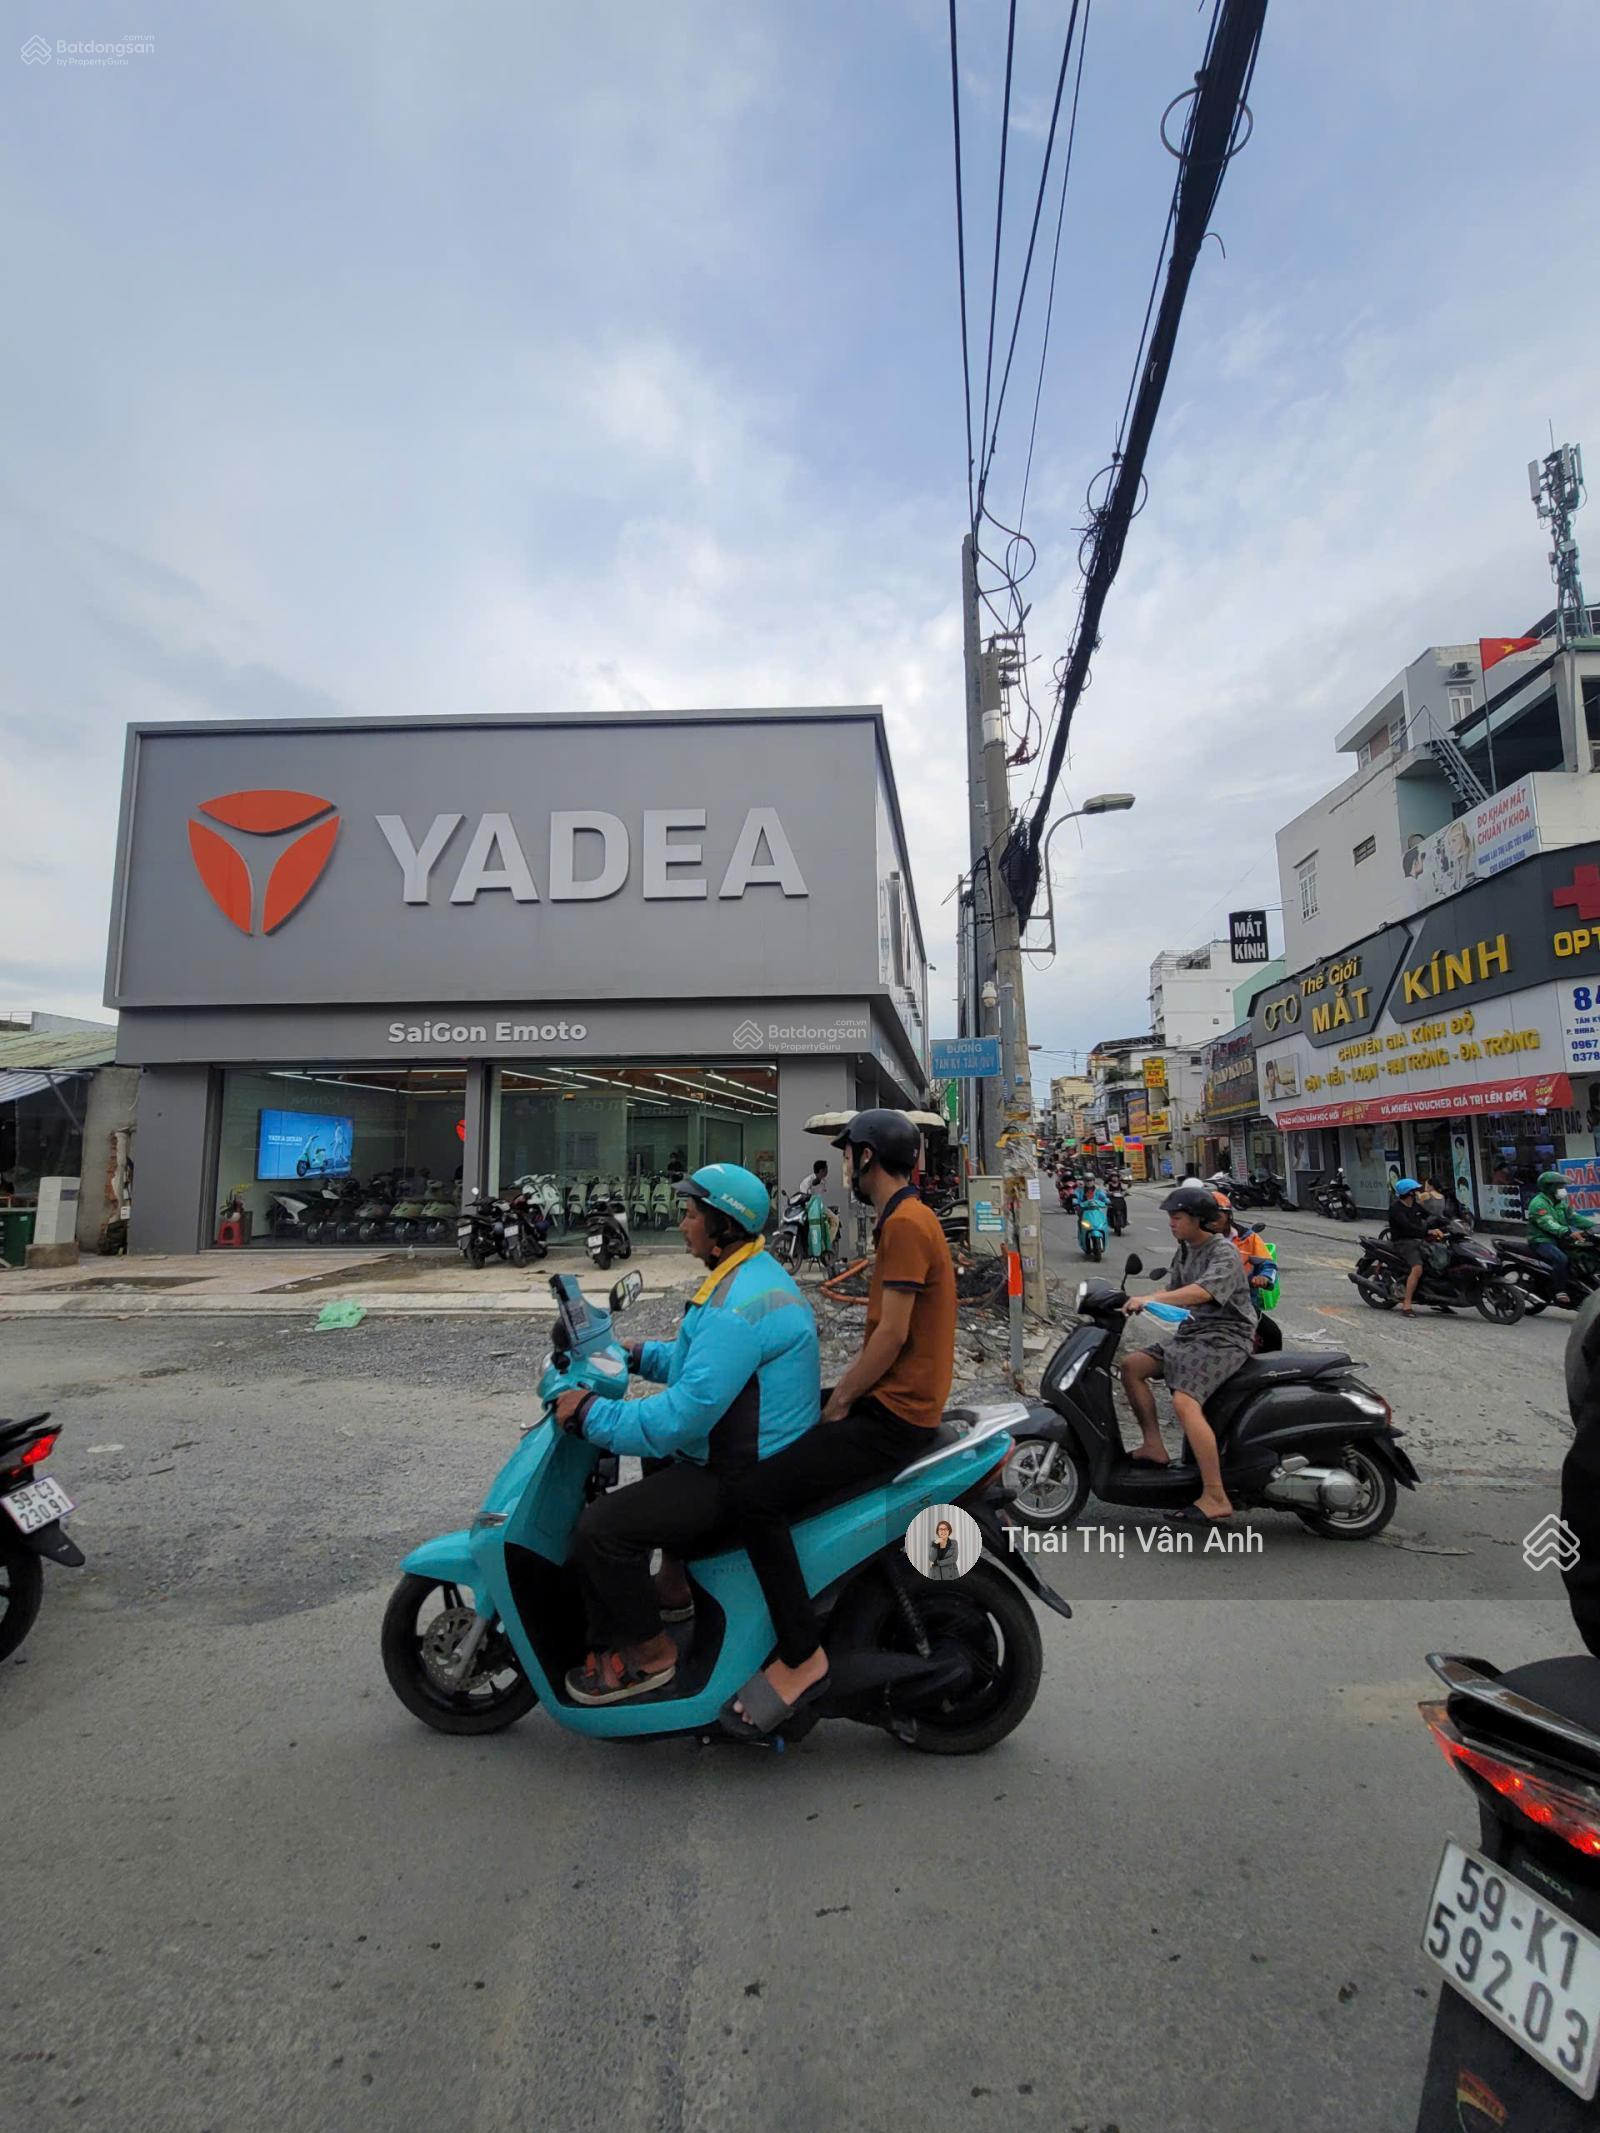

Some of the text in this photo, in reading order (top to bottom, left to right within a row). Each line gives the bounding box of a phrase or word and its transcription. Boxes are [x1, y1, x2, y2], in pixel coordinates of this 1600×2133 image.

[375, 807, 809, 905] YADEA
[1233, 914, 1263, 938] MẮT
[1234, 939, 1266, 960] KÍNH
[1300, 956, 1357, 997] Thế Giới
[1311, 933, 1511, 1034] MẮT KÍNH
[388, 1021, 587, 1043] SaiGon Emoto
[1386, 1031, 1407, 1050] GIA
[1411, 1021, 1447, 1044] KÍNH
[1450, 1010, 1475, 1036] ĐỘ
[1459, 1041, 1481, 1062] ĐA
[1414, 1098, 1452, 1112] VOUCHER
[1453, 1094, 1469, 1107] GIÁ
[1469, 1094, 1484, 1107] TRỊ
[1485, 1090, 1503, 1105] LÊN
[1505, 1086, 1527, 1102] ĐẾN
[1565, 1161, 1600, 1185] MẮ
[10, 1481, 54, 1510] 59-C3
[19, 1495, 70, 1529] 230.91
[1456, 1857, 1579, 1991] 59-K1
[1428, 1902, 1589, 2074] 592.03
